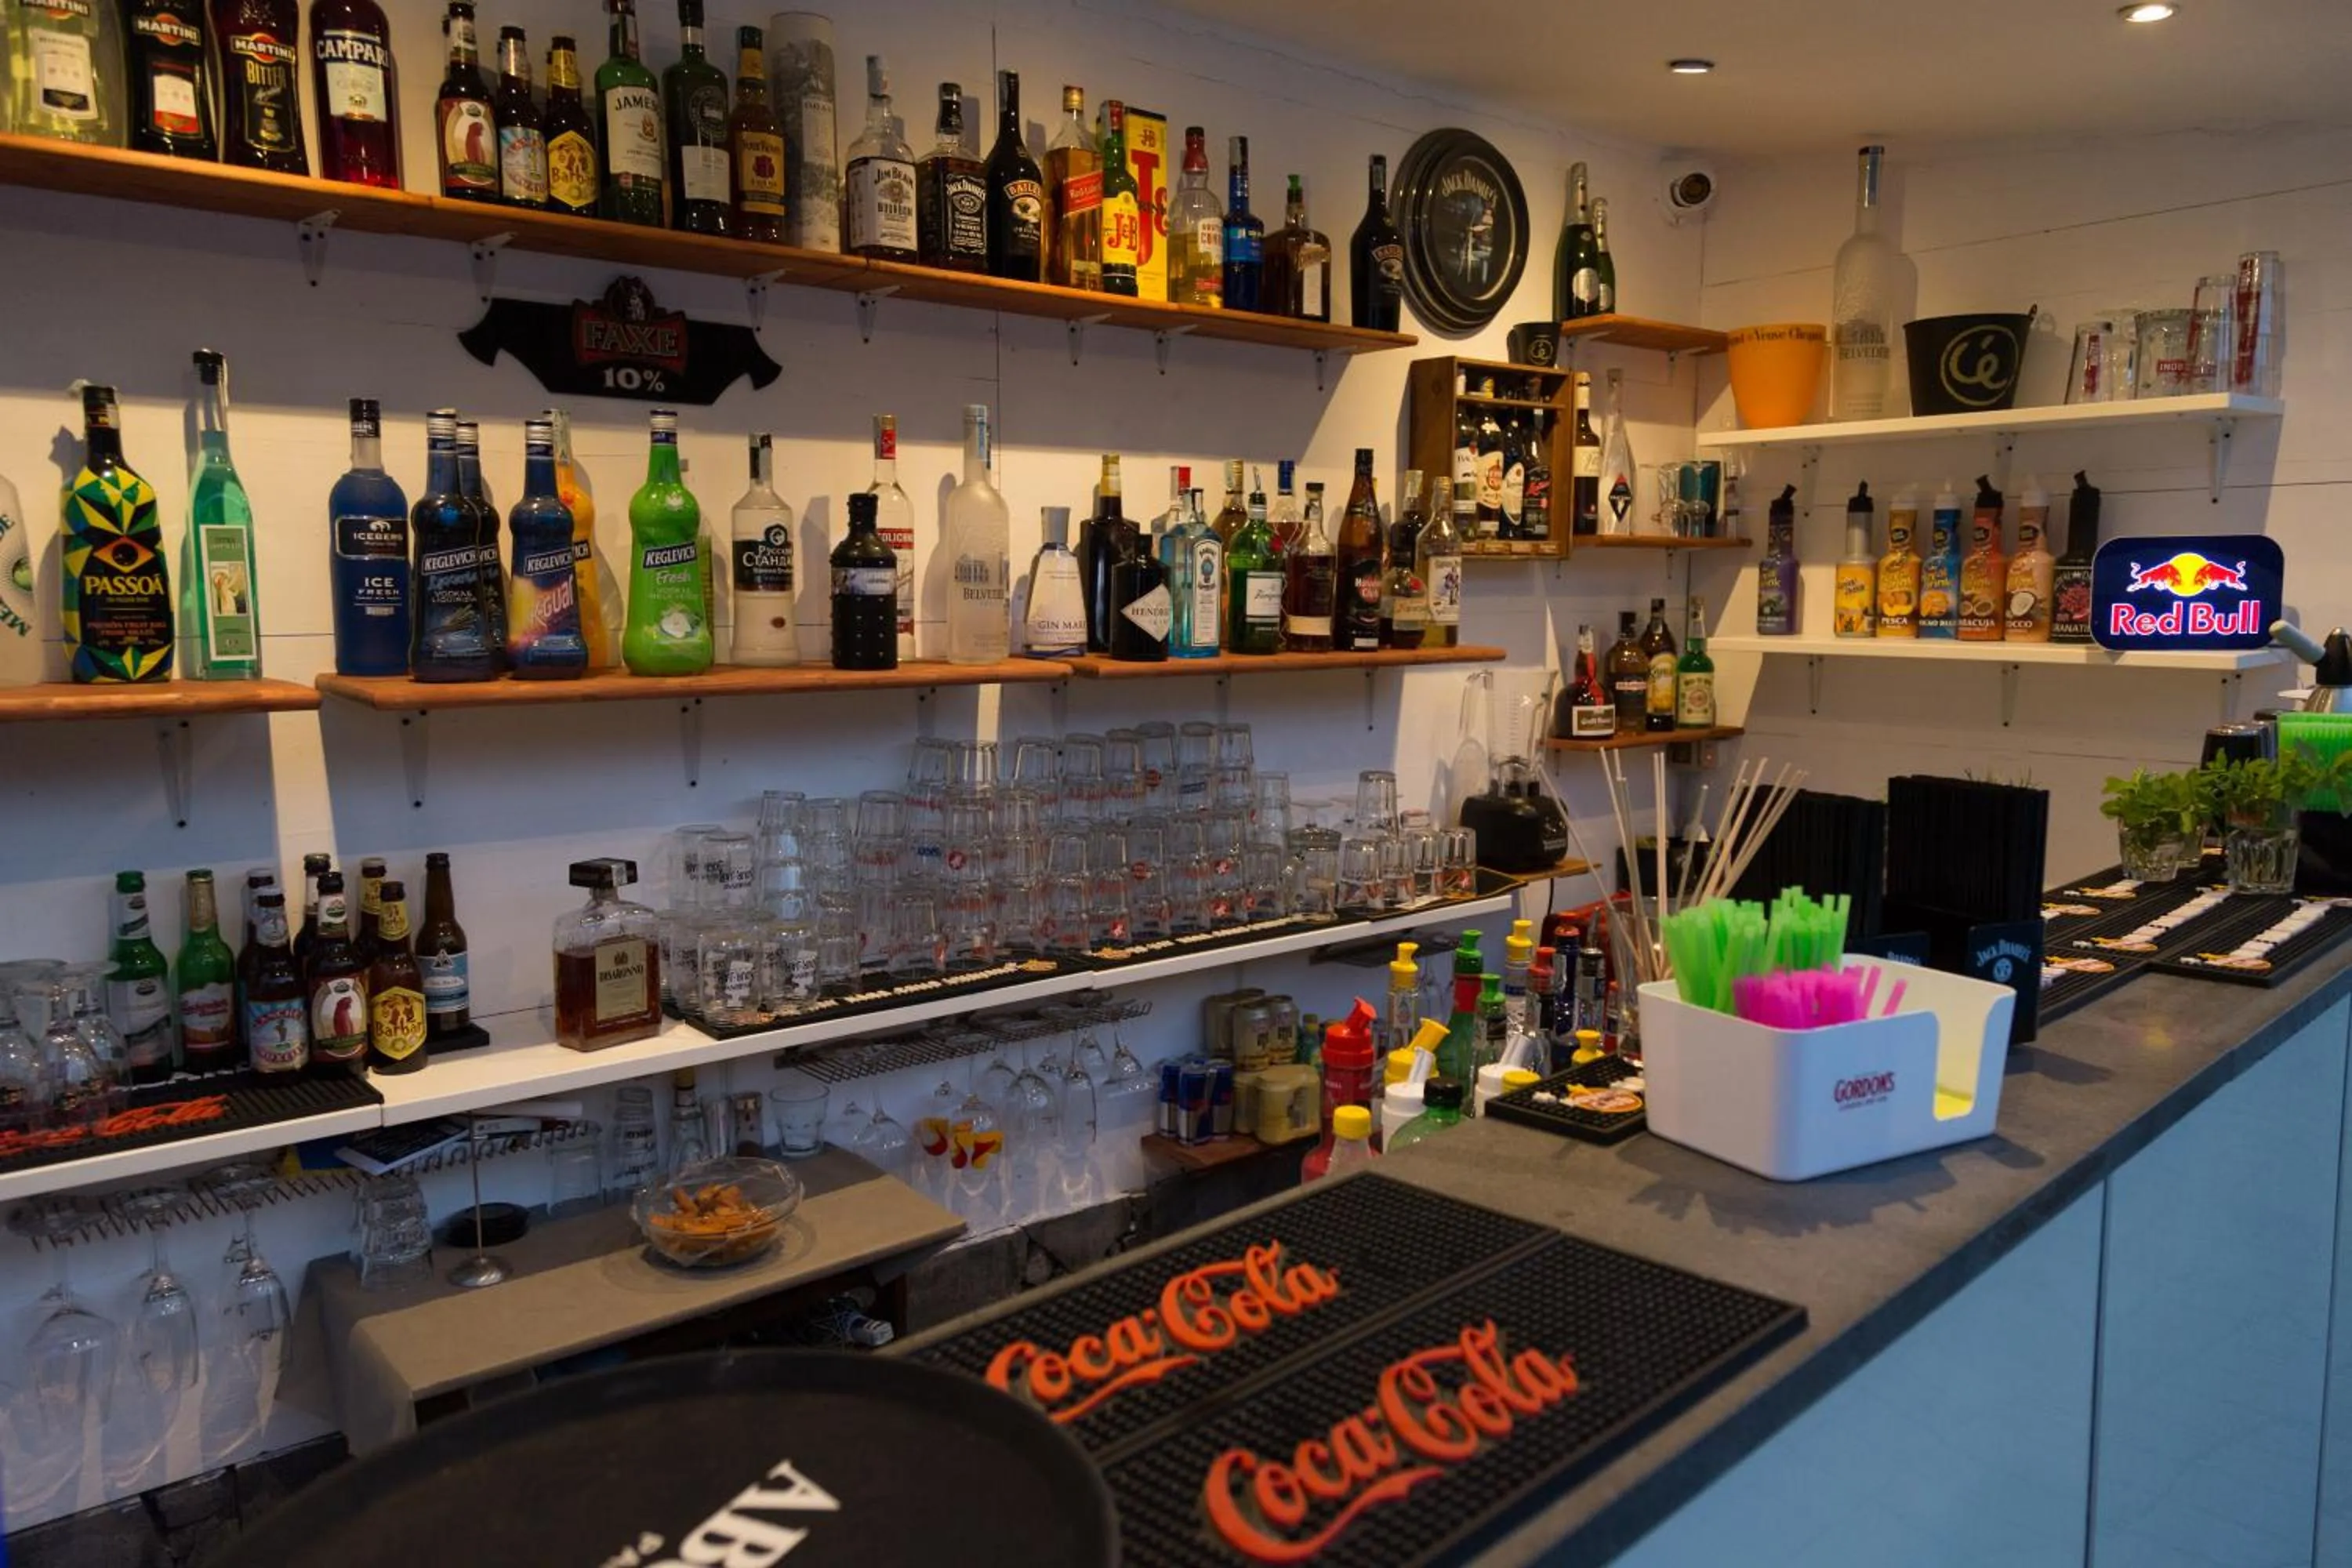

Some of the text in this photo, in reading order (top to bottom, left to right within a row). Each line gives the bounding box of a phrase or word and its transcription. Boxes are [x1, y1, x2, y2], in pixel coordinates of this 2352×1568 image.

[137, 18, 199, 42] MARTINI
[234, 38, 294, 63] MARTINI
[317, 37, 390, 63] CAMPARI
[583, 319, 681, 358] FAXE
[602, 366, 666, 392] 10%
[644, 546, 696, 567] KEGLEVICH
[358, 588, 401, 597] FRESH
[364, 577, 395, 589] ICE
[1038, 620, 1060, 630] GIN
[2109, 600, 2261, 636] Red Bull
[1976, 946, 1998, 967] JACK
[374, 1018, 423, 1038] Barbar
[984, 1239, 1339, 1424] Coca-Cola
[1205, 1319, 1578, 1563] Coca-Cola
